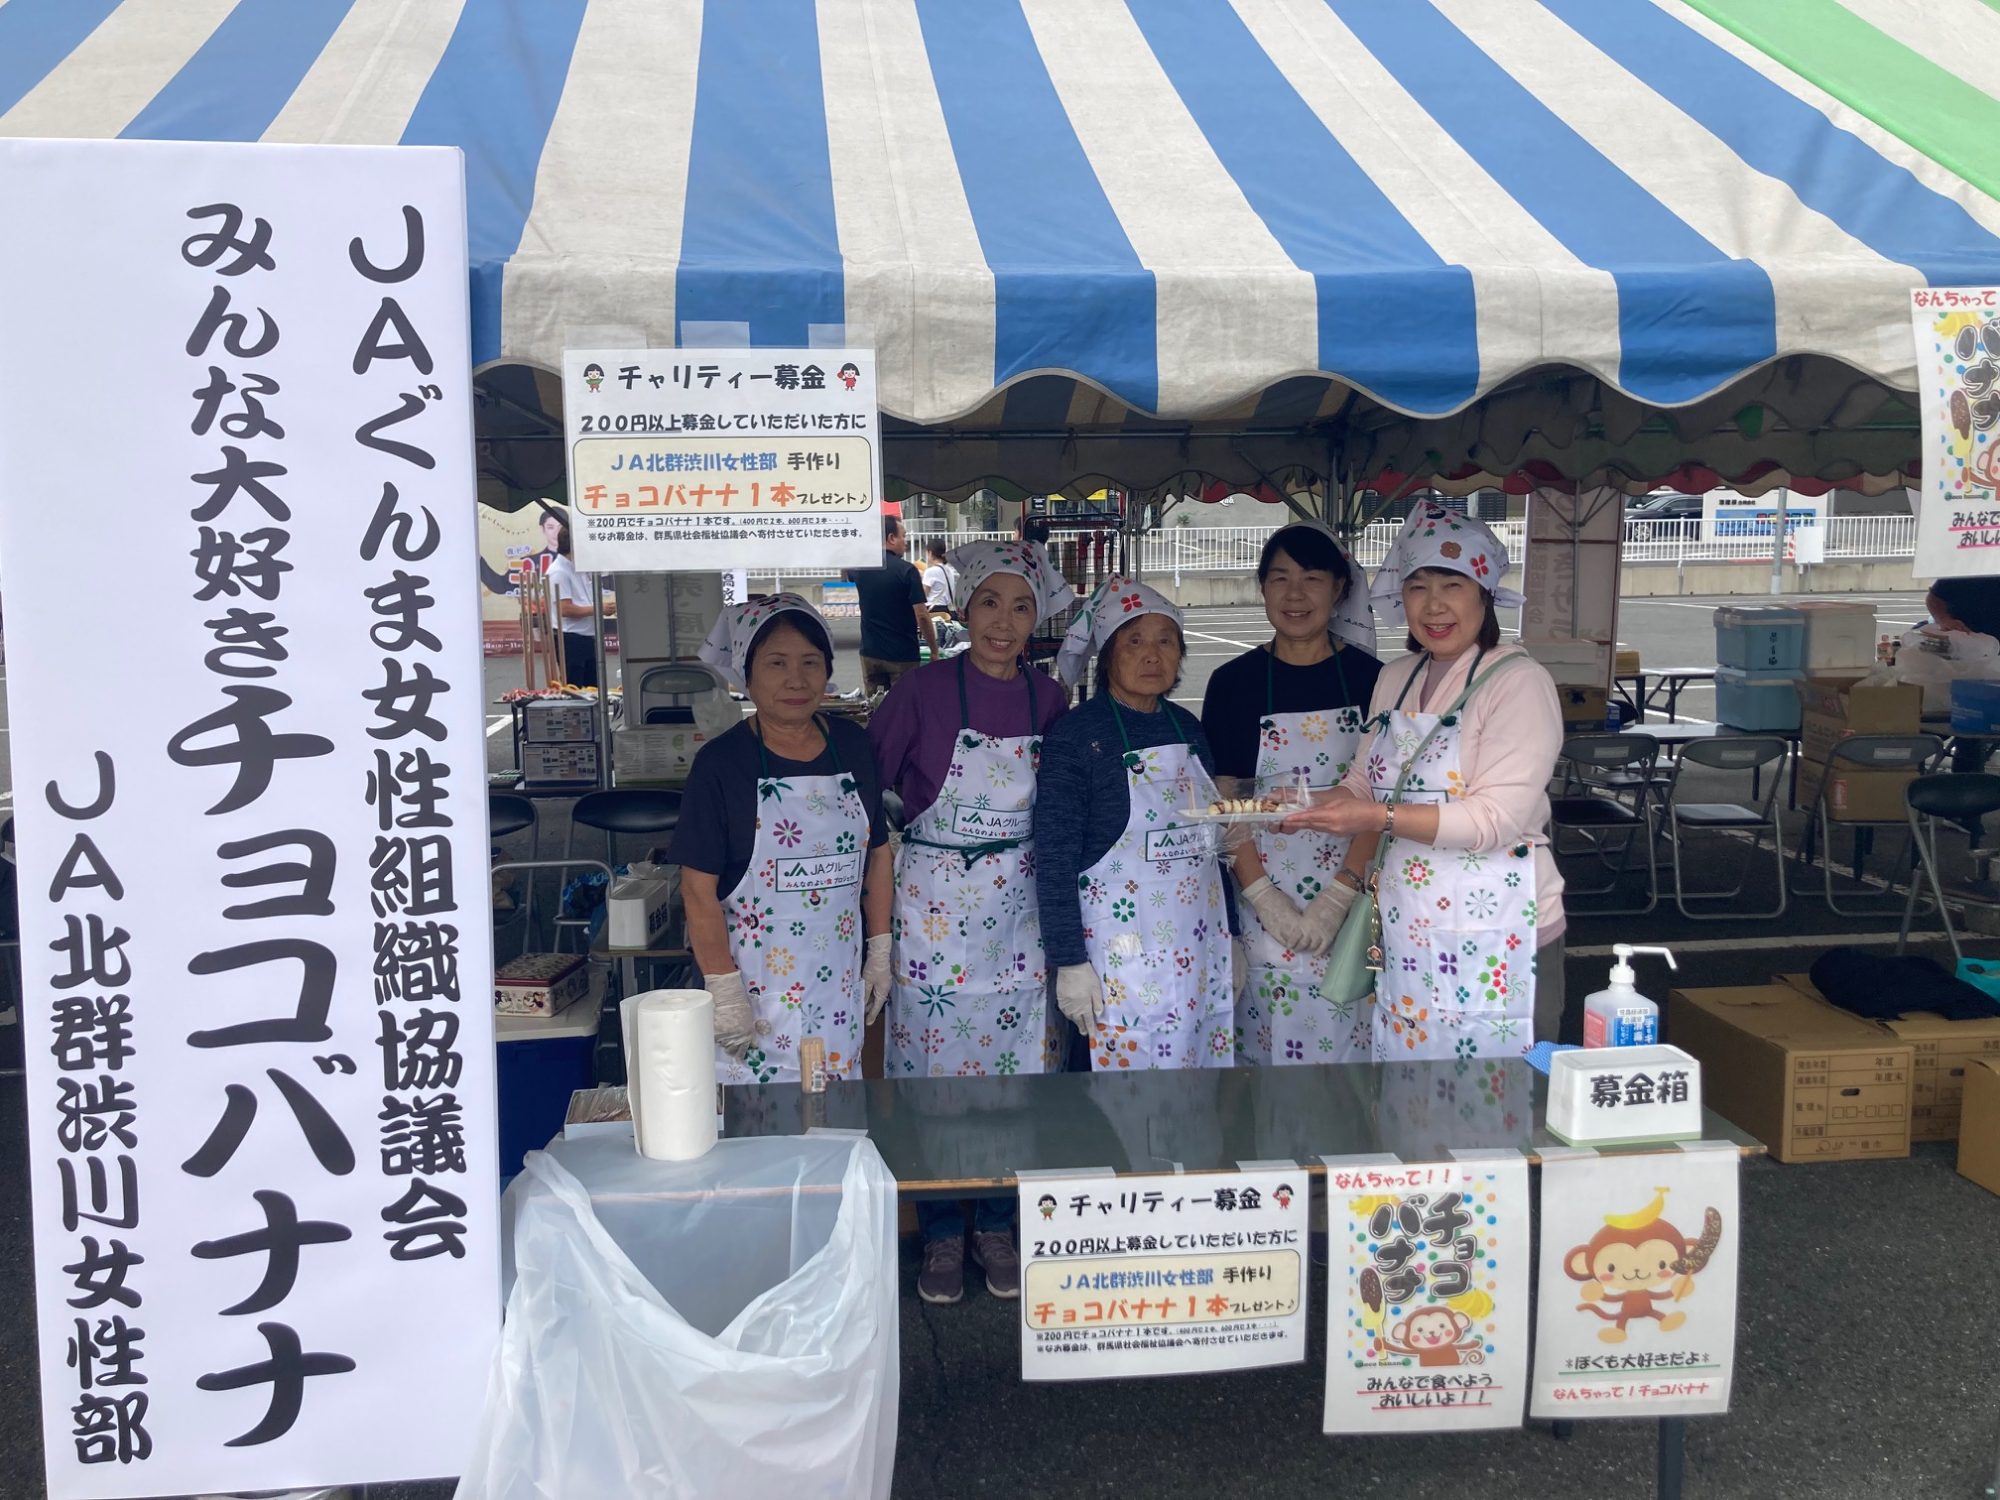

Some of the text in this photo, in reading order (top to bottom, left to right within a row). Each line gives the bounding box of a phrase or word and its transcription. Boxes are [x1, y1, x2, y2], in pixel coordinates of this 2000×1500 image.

[617, 363, 826, 391] チャリティー募金
[580, 412, 867, 433] 200円以上募金していただいた方に
[611, 452, 840, 472] JA北群渋川女性部 手作り
[348, 204, 468, 1261] JAぐんま女性組織協議会
[166, 202, 357, 1448] みんな大好きチョコバナナ
[1590, 1070, 1689, 1108] 募金箱
[45, 750, 153, 1465] JA北群渋川女性部
[1069, 1186, 1262, 1217] チャリティー募金
[1033, 1229, 1298, 1256] 200円以上募金していただいた方に
[1060, 1265, 1272, 1291] JA北群渋川女性部 手作り
[1367, 1373, 1493, 1391] みんなで食べよう
